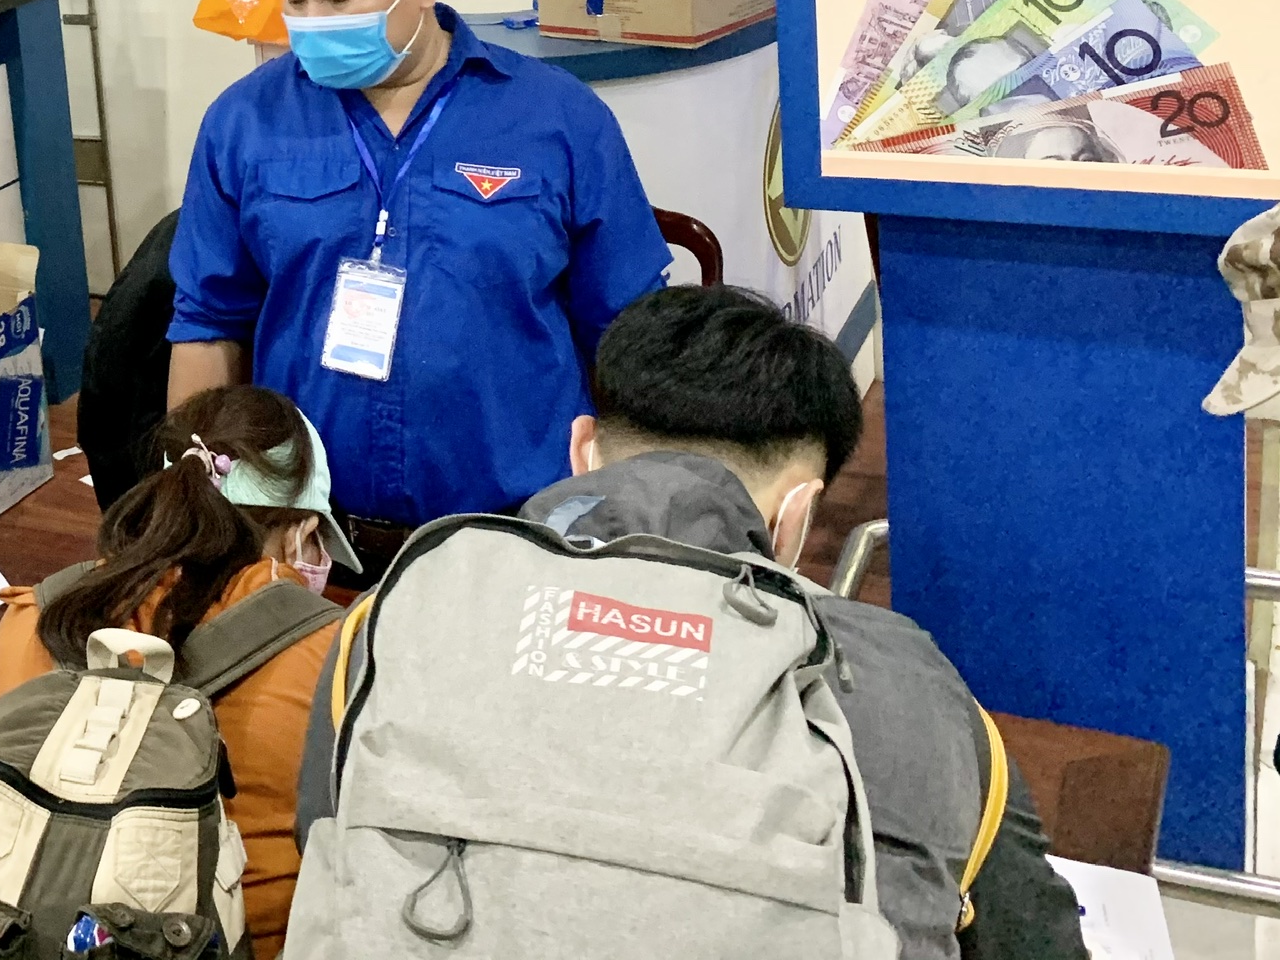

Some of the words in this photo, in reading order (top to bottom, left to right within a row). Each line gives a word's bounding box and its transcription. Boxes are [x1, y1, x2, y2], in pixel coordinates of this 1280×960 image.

[1079, 29, 1162, 87] 10
[1151, 90, 1230, 138] 20
[10, 378, 33, 463] AQUAFINA
[528, 590, 557, 677] FASHION
[577, 601, 705, 641] HASUN
